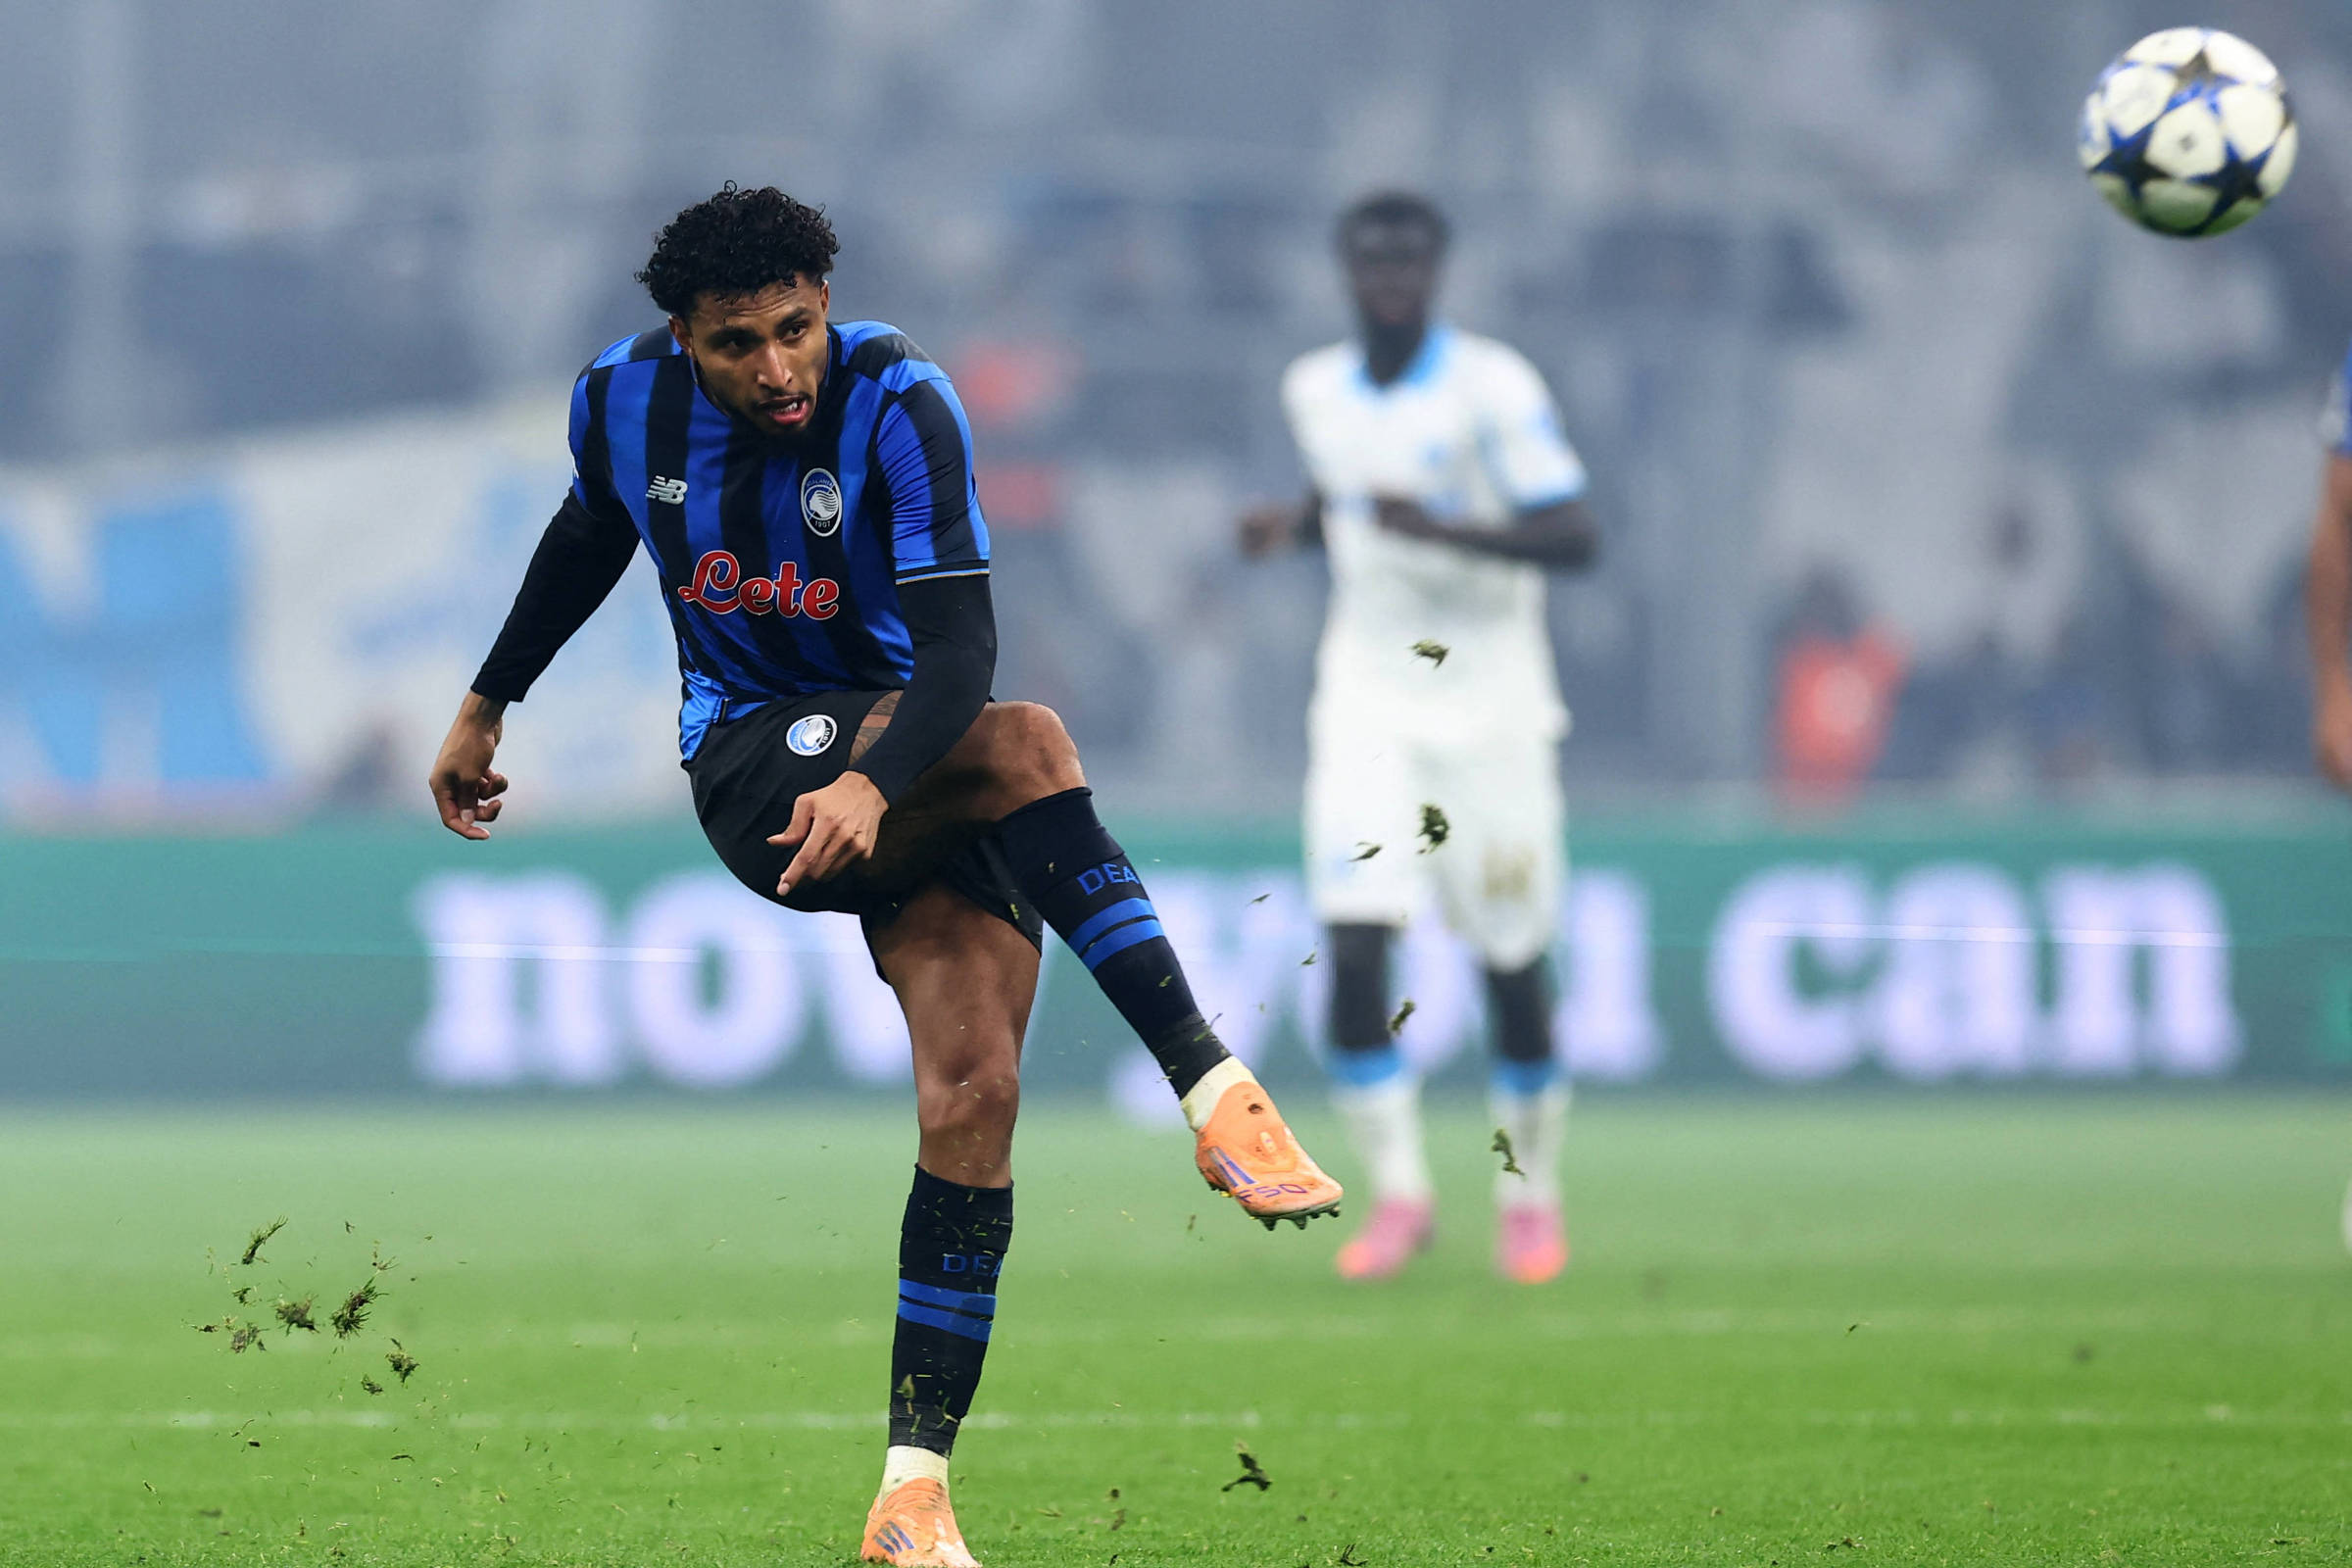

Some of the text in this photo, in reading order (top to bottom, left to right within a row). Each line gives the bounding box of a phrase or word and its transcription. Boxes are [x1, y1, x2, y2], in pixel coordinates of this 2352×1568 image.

[678, 550, 839, 620] Lete
[1077, 862, 1141, 895] DEA
[1710, 862, 2242, 1080] can
